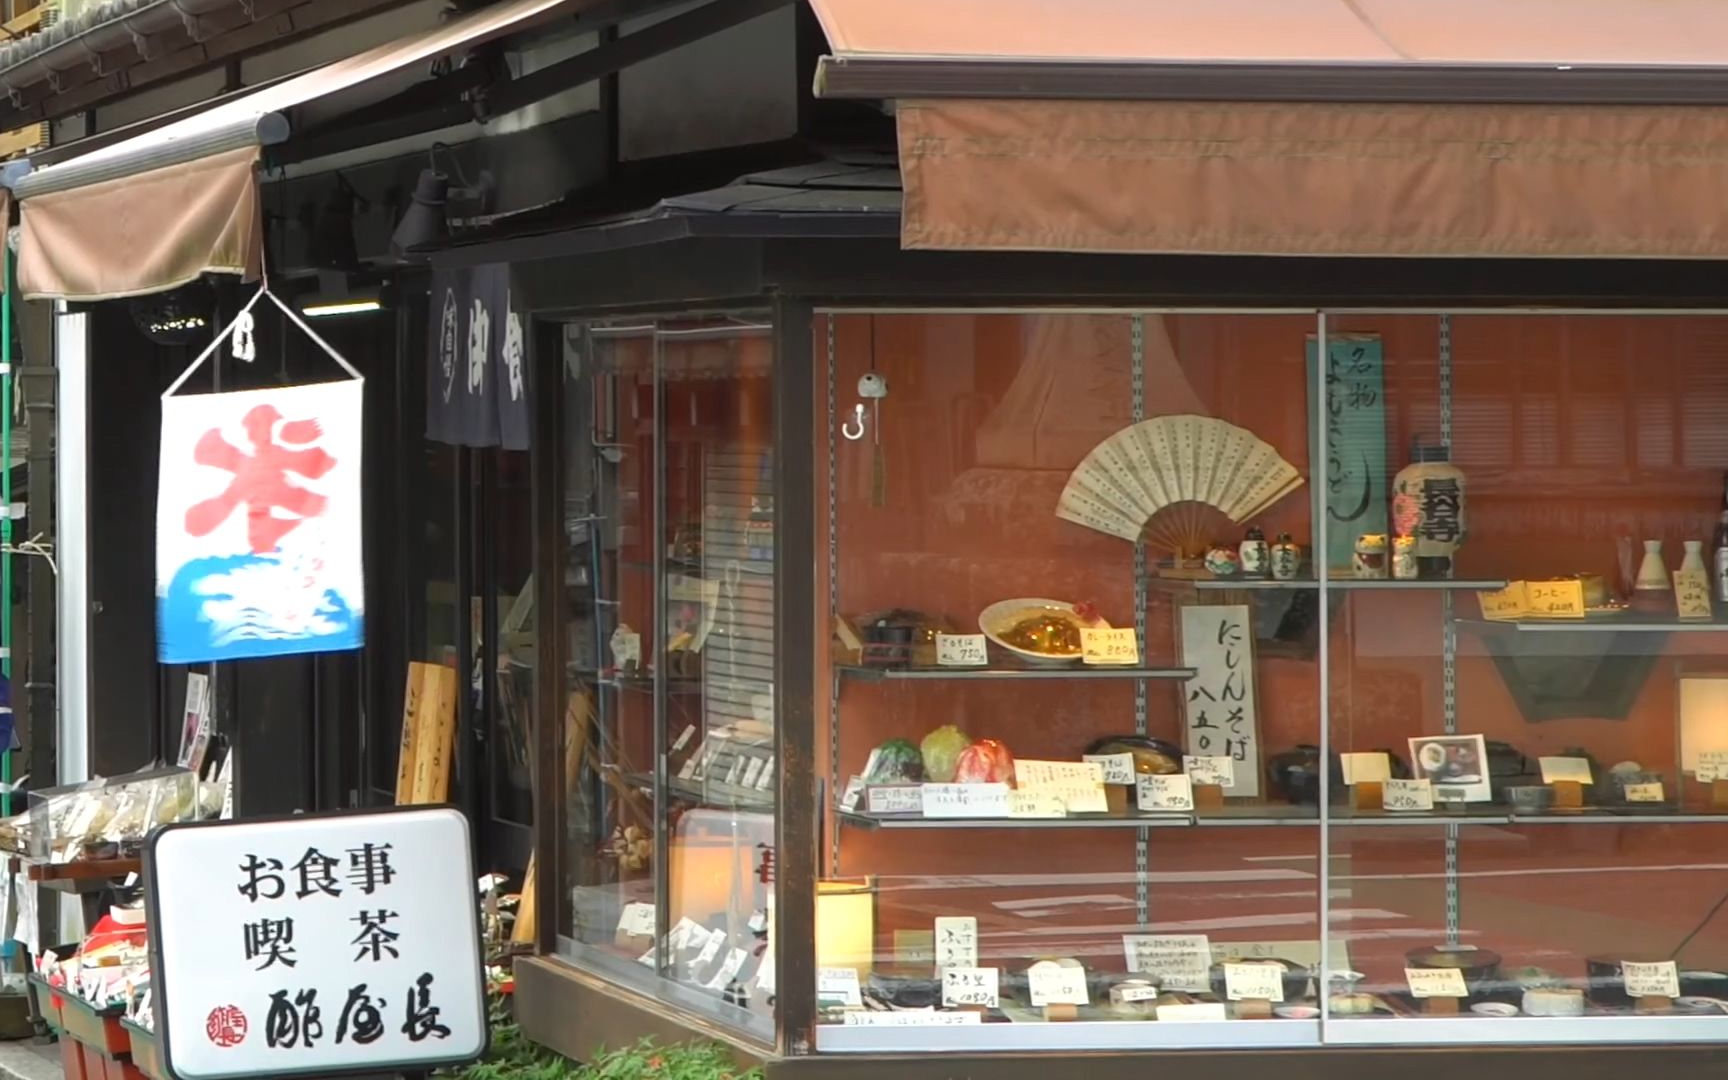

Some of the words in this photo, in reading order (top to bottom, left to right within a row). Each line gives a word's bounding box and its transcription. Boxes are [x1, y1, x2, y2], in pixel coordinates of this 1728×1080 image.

[184, 404, 338, 554] 氷
[1217, 619, 1250, 761] にしんそば
[237, 842, 397, 903] お食事
